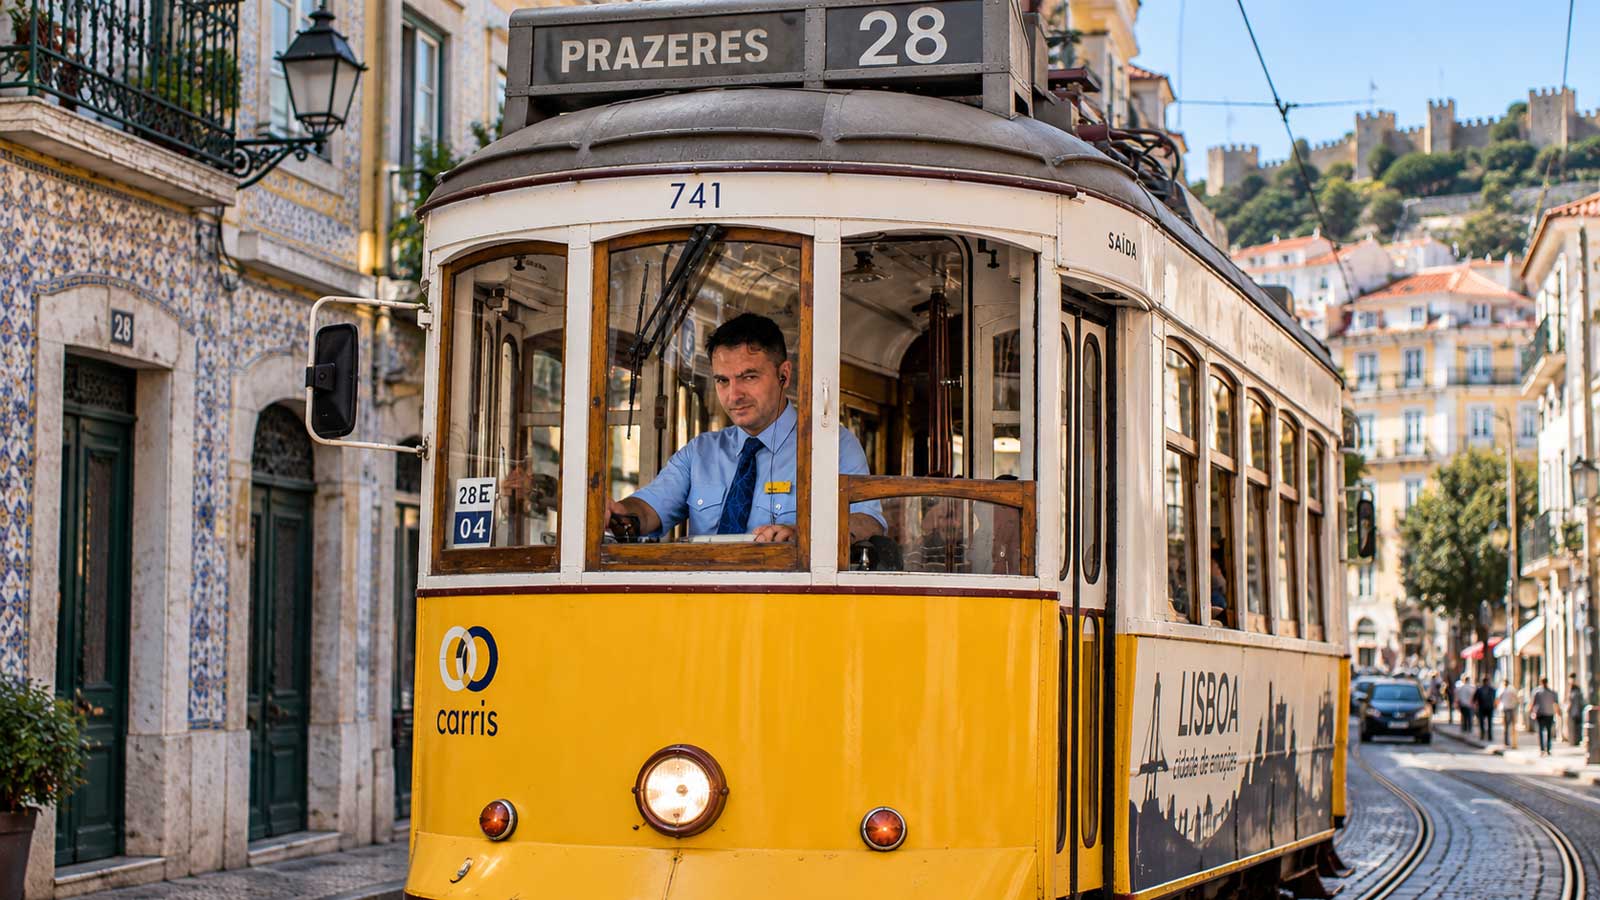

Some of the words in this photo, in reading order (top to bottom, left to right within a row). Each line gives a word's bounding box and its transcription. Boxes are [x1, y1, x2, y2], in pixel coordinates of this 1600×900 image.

[561, 28, 769, 73] PRAZERES
[859, 6, 948, 66] 28
[670, 182, 720, 209] 741
[1108, 231, 1137, 261] SAÍDA
[114, 313, 132, 342] 28
[459, 483, 493, 505] 28E
[460, 516, 486, 539] 04
[436, 699, 499, 737] carris
[1177, 671, 1238, 737] LISBOA
[1172, 747, 1199, 780] cidade
[1199, 747, 1210, 776] de
